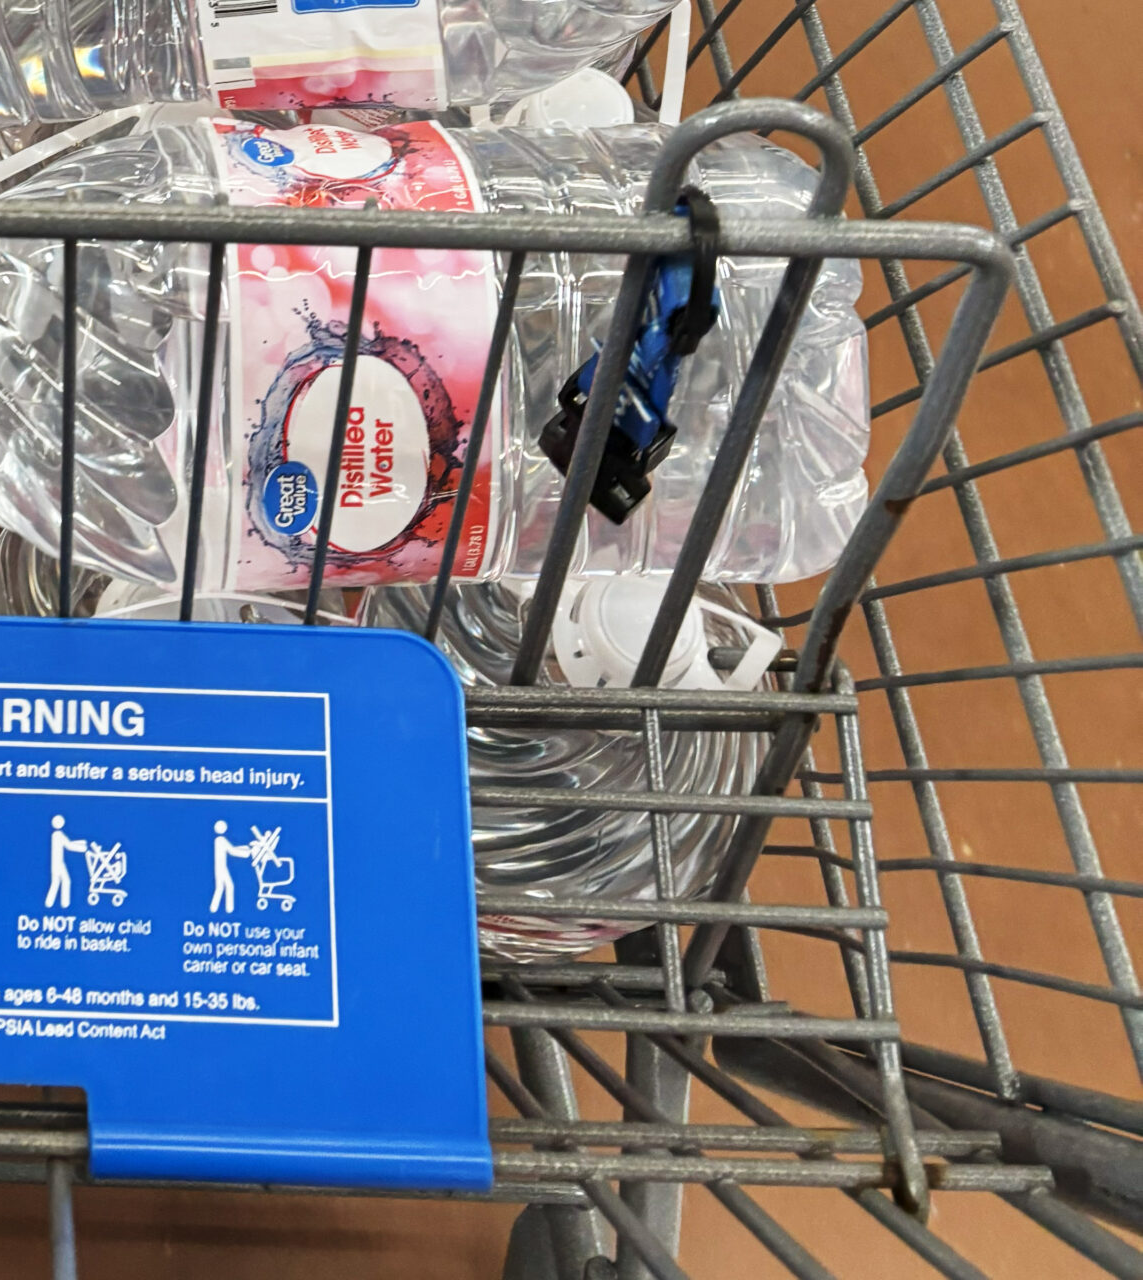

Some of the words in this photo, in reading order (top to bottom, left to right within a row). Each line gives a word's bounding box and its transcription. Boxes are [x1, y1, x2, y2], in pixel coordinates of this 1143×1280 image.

[253, 141, 276, 163] Great
[370, 418, 394, 496] Water
[275, 474, 295, 528] Great
[294, 474, 308, 515] Value
[470, 525, 484, 534] L)
[464, 535, 484, 556] (3.78
[16, 761, 50, 778] and
[55, 762, 108, 780] suffer
[112, 766, 123, 780] a
[128, 765, 195, 782] serious
[200, 767, 243, 784] head
[249, 767, 305, 789] injury.
[18, 915, 39, 932] Do
[43, 916, 76, 933] NOT
[79, 918, 115, 934] allow
[118, 919, 151, 935] child
[183, 921, 204, 937] Do
[209, 921, 241, 939] NOT
[245, 925, 271, 939] use
[275, 926, 305, 945] your
[18, 934, 31, 949] to
[35, 934, 61, 950] ride
[65, 935, 78, 951] in
[81, 936, 131, 952] basket.
[183, 942, 212, 955] own
[216, 942, 276, 958] personal
[280, 942, 319, 959] infant
[183, 959, 228, 974] carrier
[232, 961, 247, 974] or
[250, 961, 272, 975] car
[276, 962, 310, 977] seat.
[4, 988, 43, 1006] ages
[46, 987, 82, 1004] 6-48
[86, 989, 144, 1006] months
[148, 991, 178, 1007] and
[184, 992, 228, 1009] 15-35
[232, 993, 261, 1011] lbs.
[36, 1020, 73, 1038] Lead
[77, 1021, 138, 1039] Content
[141, 1023, 166, 1039] Act
